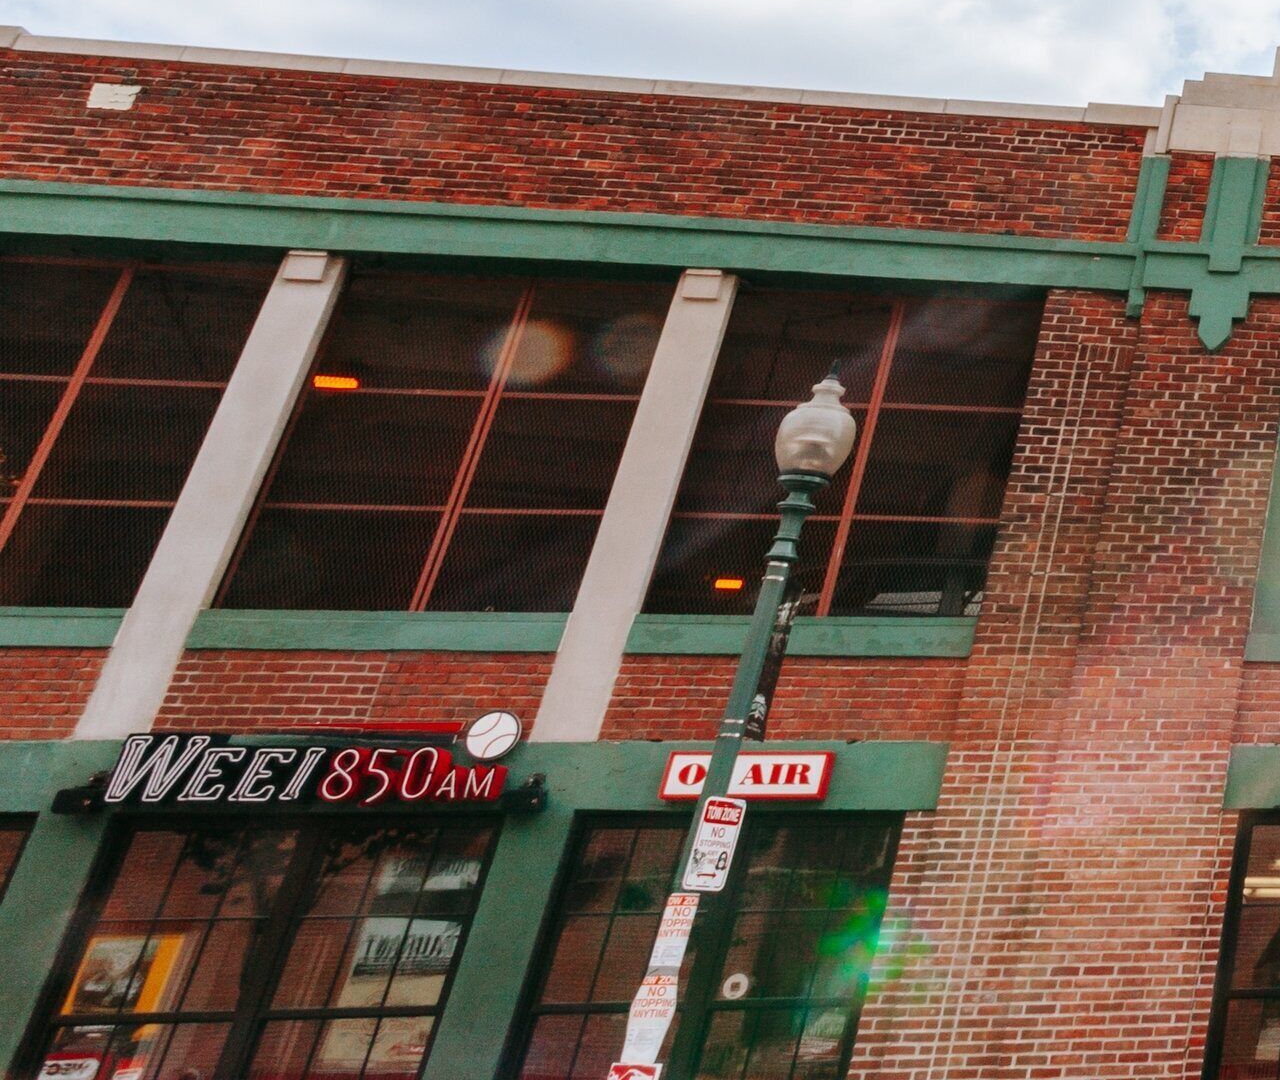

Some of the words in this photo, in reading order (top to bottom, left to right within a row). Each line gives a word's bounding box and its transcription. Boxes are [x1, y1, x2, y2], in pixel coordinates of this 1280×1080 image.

[104, 735, 326, 802] WEEI
[678, 763, 707, 785] O
[739, 763, 811, 785] AIR
[706, 805, 723, 821] TOW
[721, 806, 741, 822] ZONE
[711, 827, 726, 838] NO
[699, 839, 731, 848] STOPPING
[668, 896, 683, 906] OW
[672, 907, 691, 917] NO
[642, 975, 658, 985] OW
[647, 986, 667, 997] NO
[633, 1009, 669, 1018] ANYTIME
